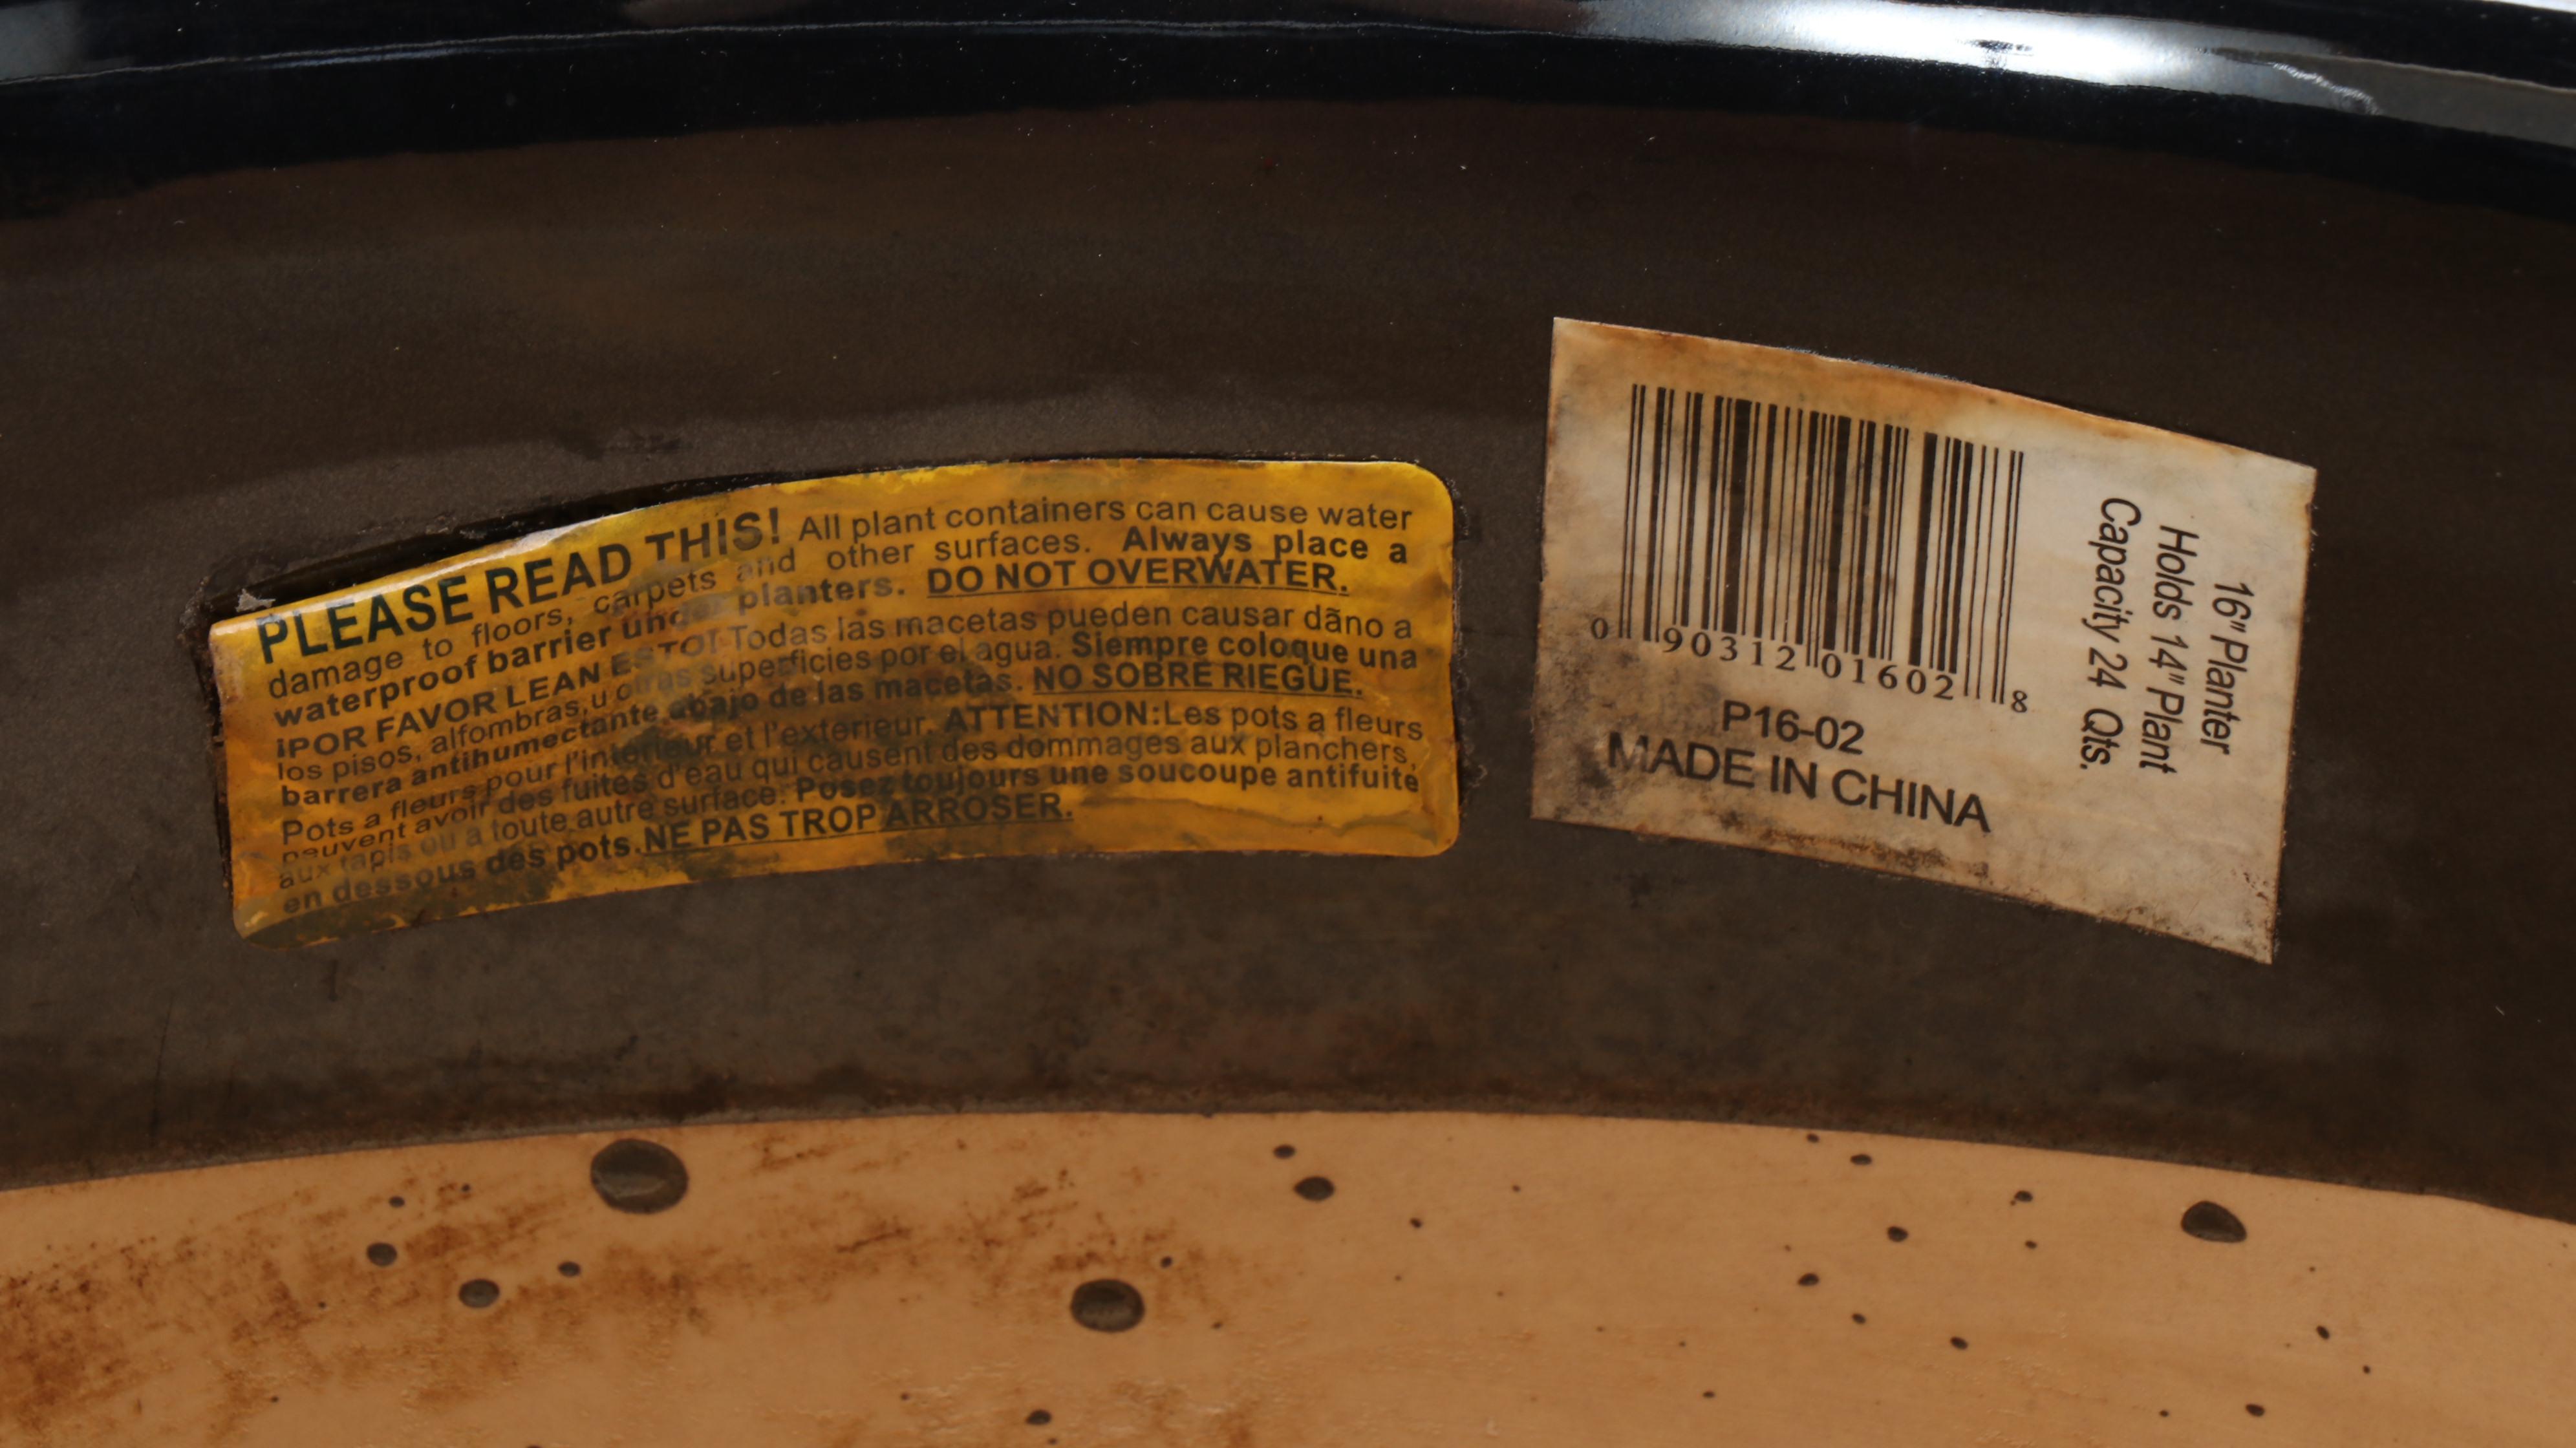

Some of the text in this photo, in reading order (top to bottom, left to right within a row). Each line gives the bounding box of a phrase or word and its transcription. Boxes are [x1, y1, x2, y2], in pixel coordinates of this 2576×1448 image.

[256, 496, 1411, 665] PLEASE READ THIS! All plant containers can cause water
[269, 650, 403, 699] damage
[423, 637, 453, 661] to
[471, 608, 573, 648] floors,
[594, 570, 716, 614] carpets
[827, 542, 914, 571] other
[934, 531, 1091, 562] surfaces.
[1122, 526, 1252, 558] Always
[1274, 529, 1368, 560] place
[1390, 543, 1408, 564] a
[2080, 498, 2141, 769] Capacity 24 Qts.
[2153, 525, 2199, 621] Holds
[274, 655, 478, 727] waterproof
[488, 625, 611, 675] barrier
[738, 576, 905, 614] planters.
[927, 566, 983, 593] DO
[996, 560, 1076, 590] NOT
[1088, 557, 1348, 592] OVERWATER.
[277, 763, 322, 781] los
[332, 746, 421, 783] pisos,
[592, 691, 606, 709] u
[702, 647, 870, 685] superficies
[881, 646, 930, 672] por
[939, 639, 967, 664] el
[975, 639, 1061, 667] agua.
[1072, 630, 1207, 663] Siempre
[1218, 630, 1348, 668] coloque
[1359, 646, 1417, 670] una
[377, 693, 495, 741] FAVOR
[508, 662, 599, 709] LEAN
[727, 621, 828, 651] Todas
[837, 615, 885, 642] las
[896, 608, 1035, 638] macetas
[1048, 601, 1171, 634] pueden
[1182, 604, 1293, 626] causar
[1394, 617, 1412, 639] a
[2201, 635, 2249, 754] Planter
[281, 775, 401, 807] barrera
[411, 704, 658, 787] antihumectante
[768, 686, 806, 708] de
[818, 677, 864, 704] las
[876, 668, 1022, 699] macetas.
[1035, 662, 1082, 691] NO
[1093, 661, 1211, 688] SOBRE
[1224, 662, 1362, 695] RIEGUE.
[283, 818, 354, 845] Pots
[364, 813, 381, 829] a
[391, 785, 476, 820] fleurs
[487, 764, 555, 792] pour
[725, 725, 755, 751] et
[1232, 707, 1297, 730] pots
[1307, 712, 1324, 732] a
[1335, 706, 1422, 740] fleurs
[415, 800, 489, 834] avoir
[498, 787, 553, 814] des
[561, 772, 649, 800] fuites
[658, 761, 742, 789] d'eau
[753, 754, 797, 783] qui
[809, 744, 933, 772] causent
[943, 736, 997, 761] des
[1007, 732, 1181, 761] dommages
[1190, 732, 1246, 756] aux
[1608, 731, 1990, 833] MADE IN CHINA
[1723, 700, 1864, 754] P16-02
[2138, 687, 2184, 774] Plant
[279, 864, 330, 889] aux
[421, 833, 455, 857] ou
[466, 827, 482, 847] a
[491, 811, 568, 842] toute
[577, 800, 654, 830] autre
[664, 783, 786, 818] surface.
[797, 776, 892, 802] Posez
[902, 764, 1040, 795] toujours
[1051, 763, 1108, 785] une
[1119, 763, 1276, 790] soucoupe
[1287, 762, 1419, 793] antifuite
[283, 891, 322, 913] en
[332, 860, 476, 903] dessous
[486, 847, 545, 873] des
[702, 813, 769, 845] PAS
[780, 803, 876, 837] TROP
[885, 793, 1073, 827] ARROSER.
